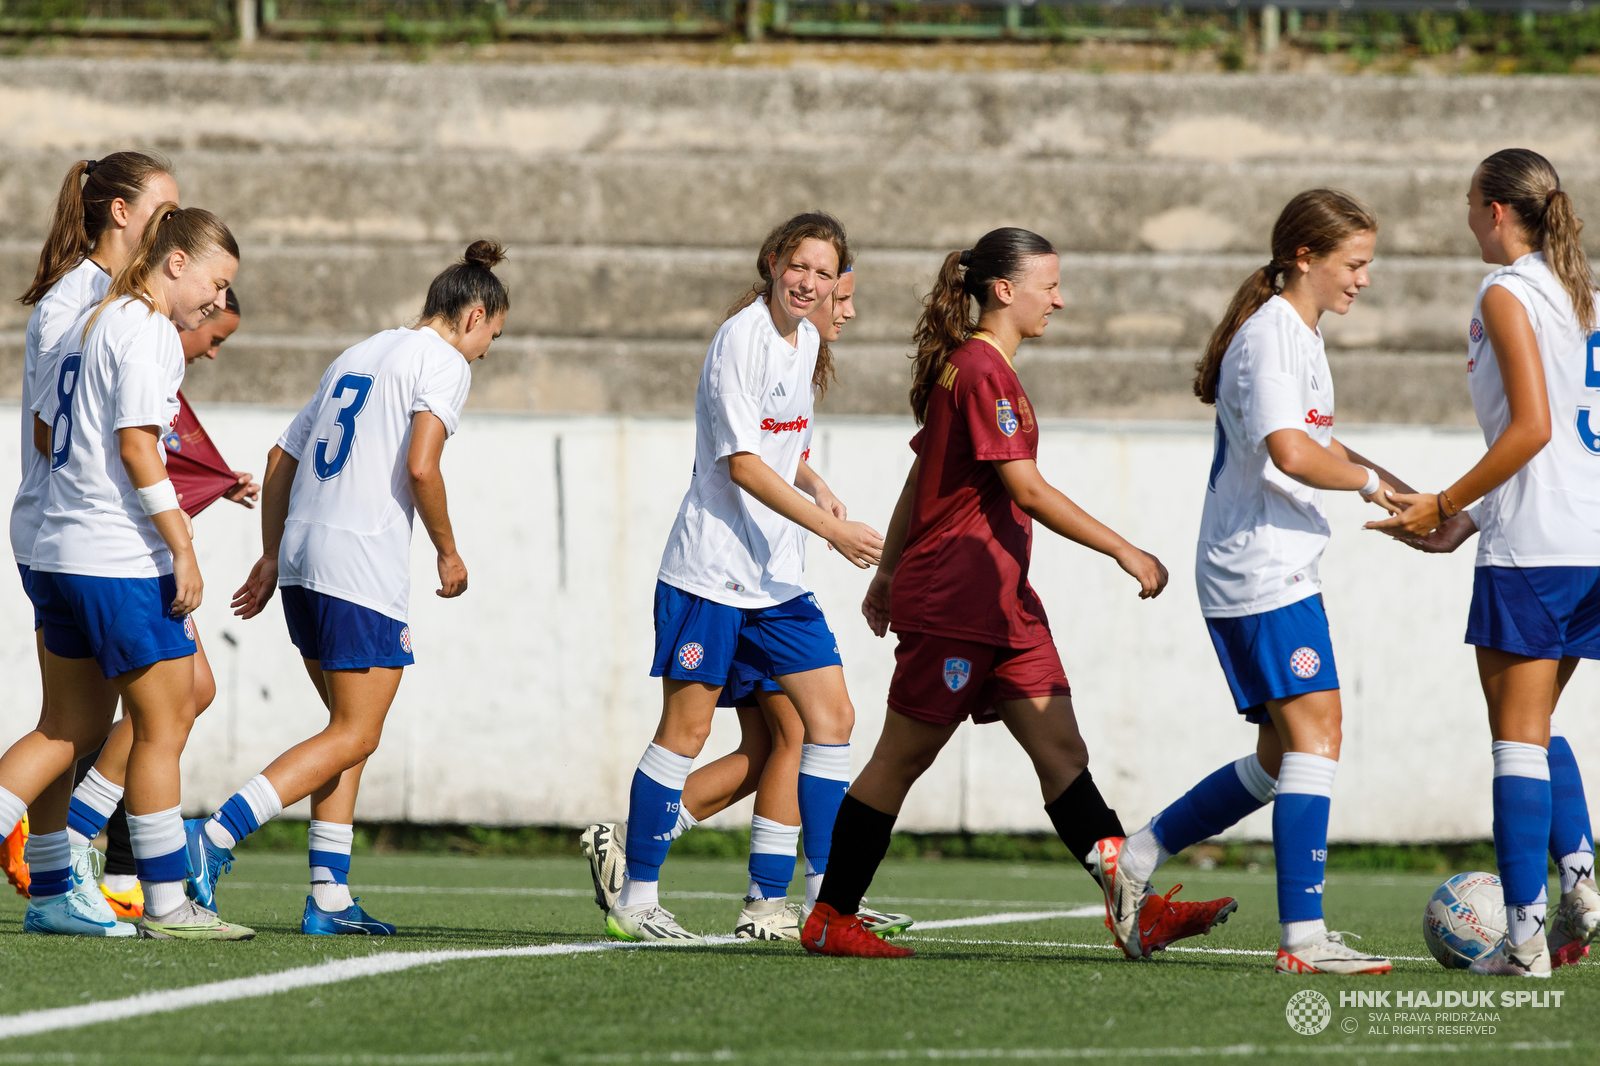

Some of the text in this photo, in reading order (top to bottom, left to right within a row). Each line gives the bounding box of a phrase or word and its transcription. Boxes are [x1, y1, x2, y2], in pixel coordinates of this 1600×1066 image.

[51, 352, 82, 473] 8
[313, 371, 375, 482] 3
[665, 801, 681, 813] 19
